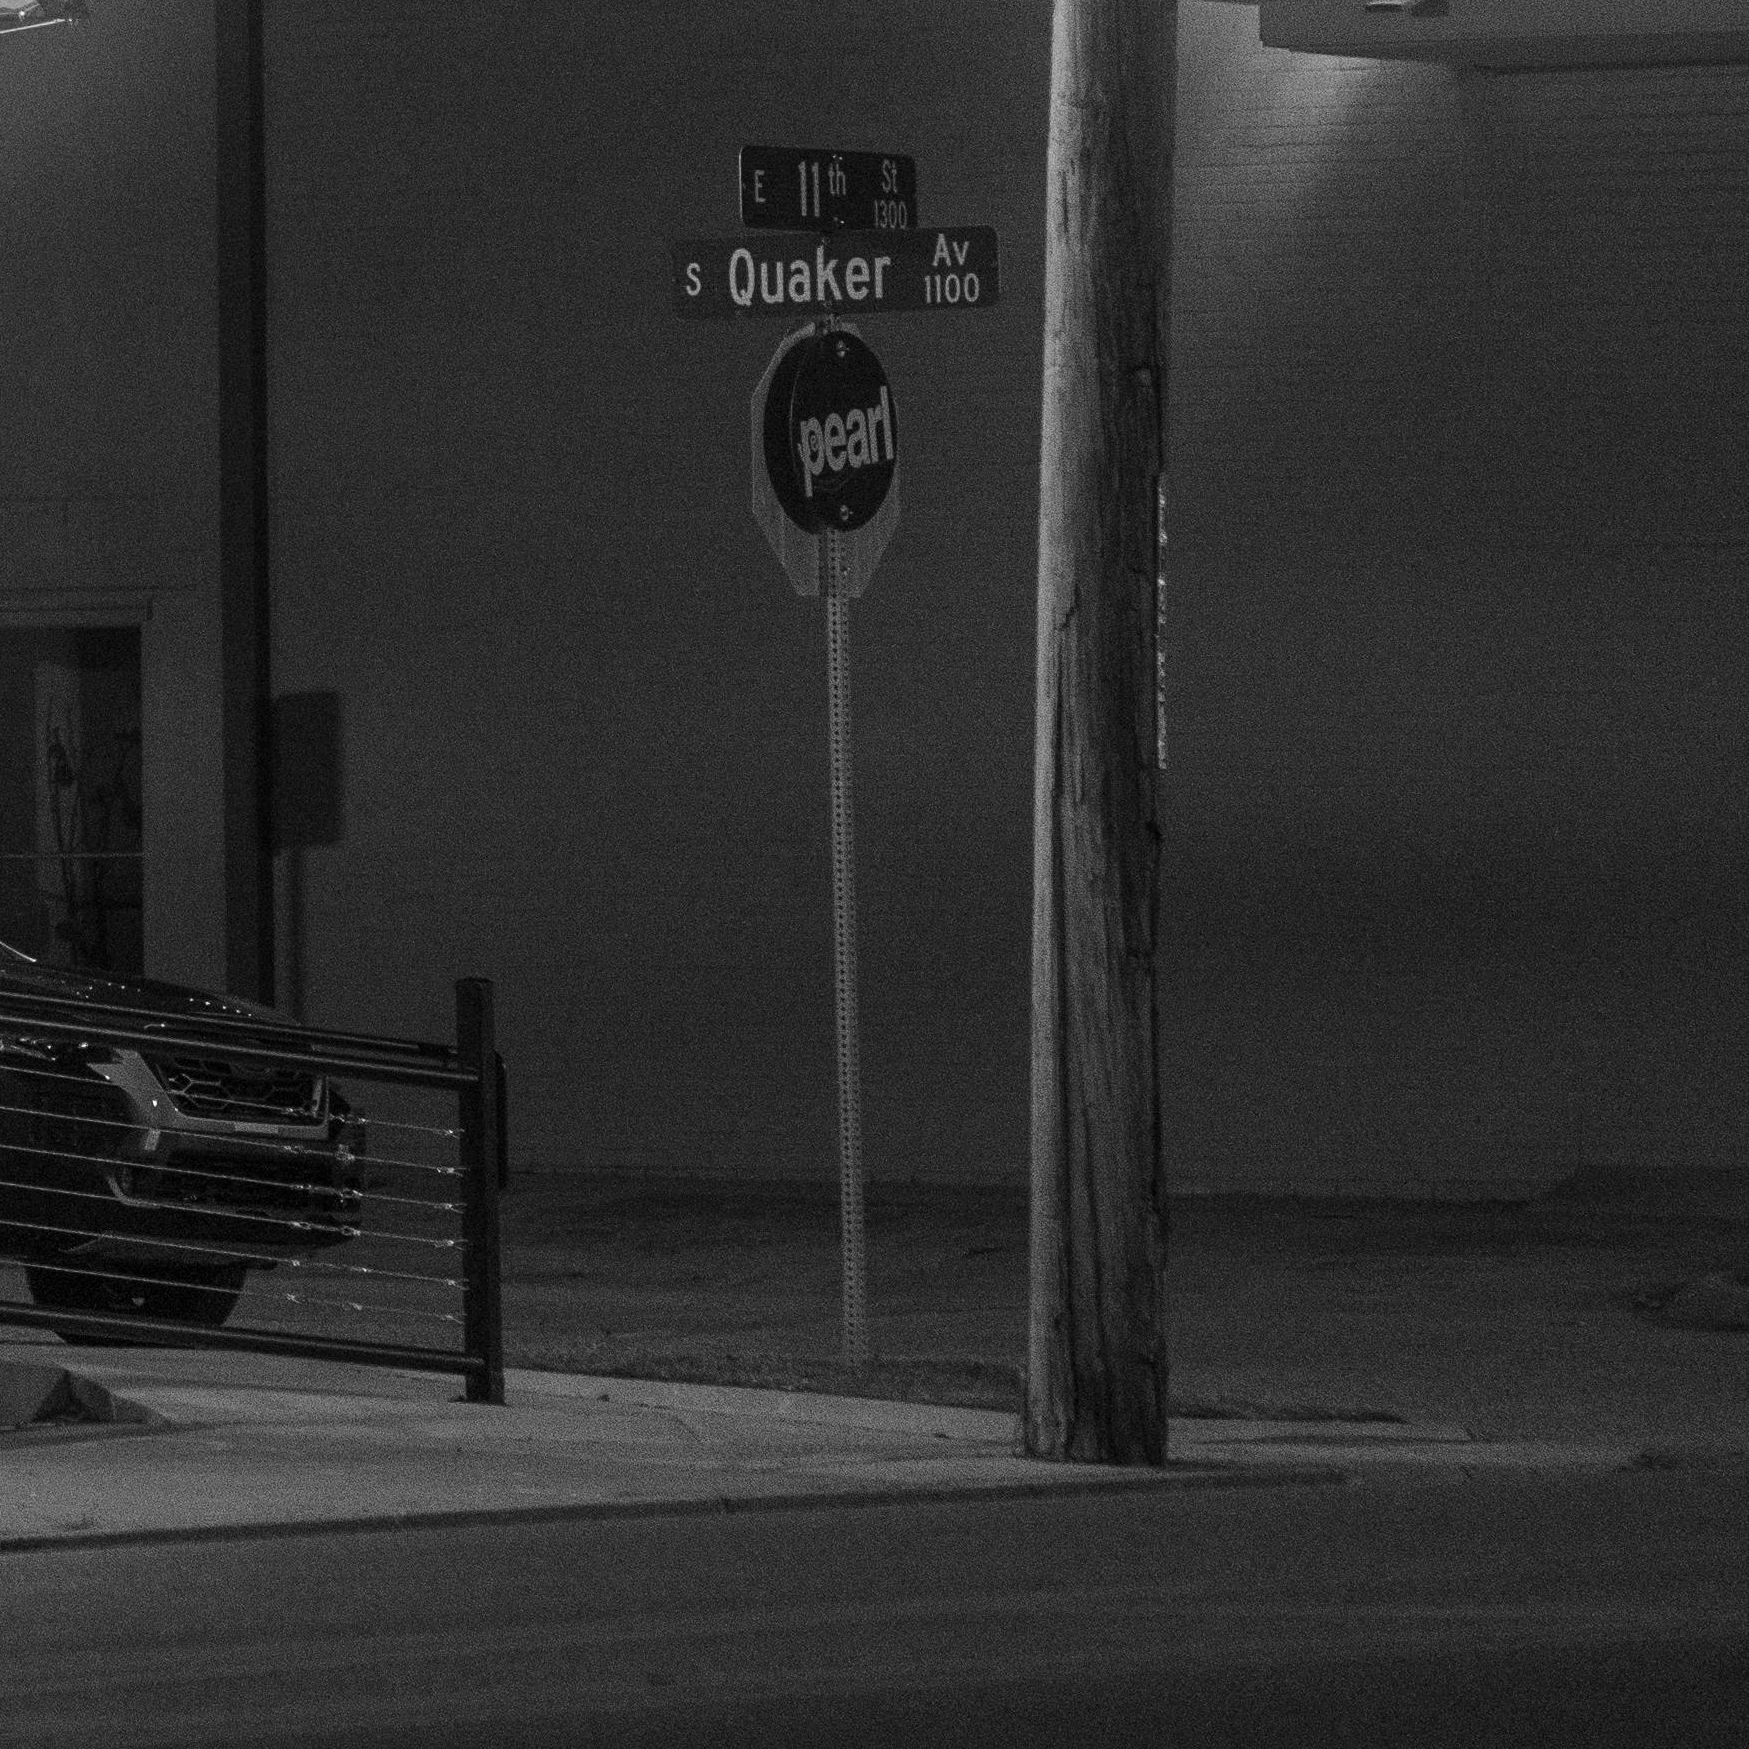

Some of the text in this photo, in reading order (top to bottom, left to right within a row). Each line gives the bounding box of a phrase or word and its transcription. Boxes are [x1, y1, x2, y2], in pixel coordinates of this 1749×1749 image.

[754, 159, 898, 217] E 11th St
[873, 200, 908, 229] 1300
[686, 233, 969, 306] S Quaker Av
[925, 273, 980, 304] 1100
[797, 385, 894, 497] pearl
